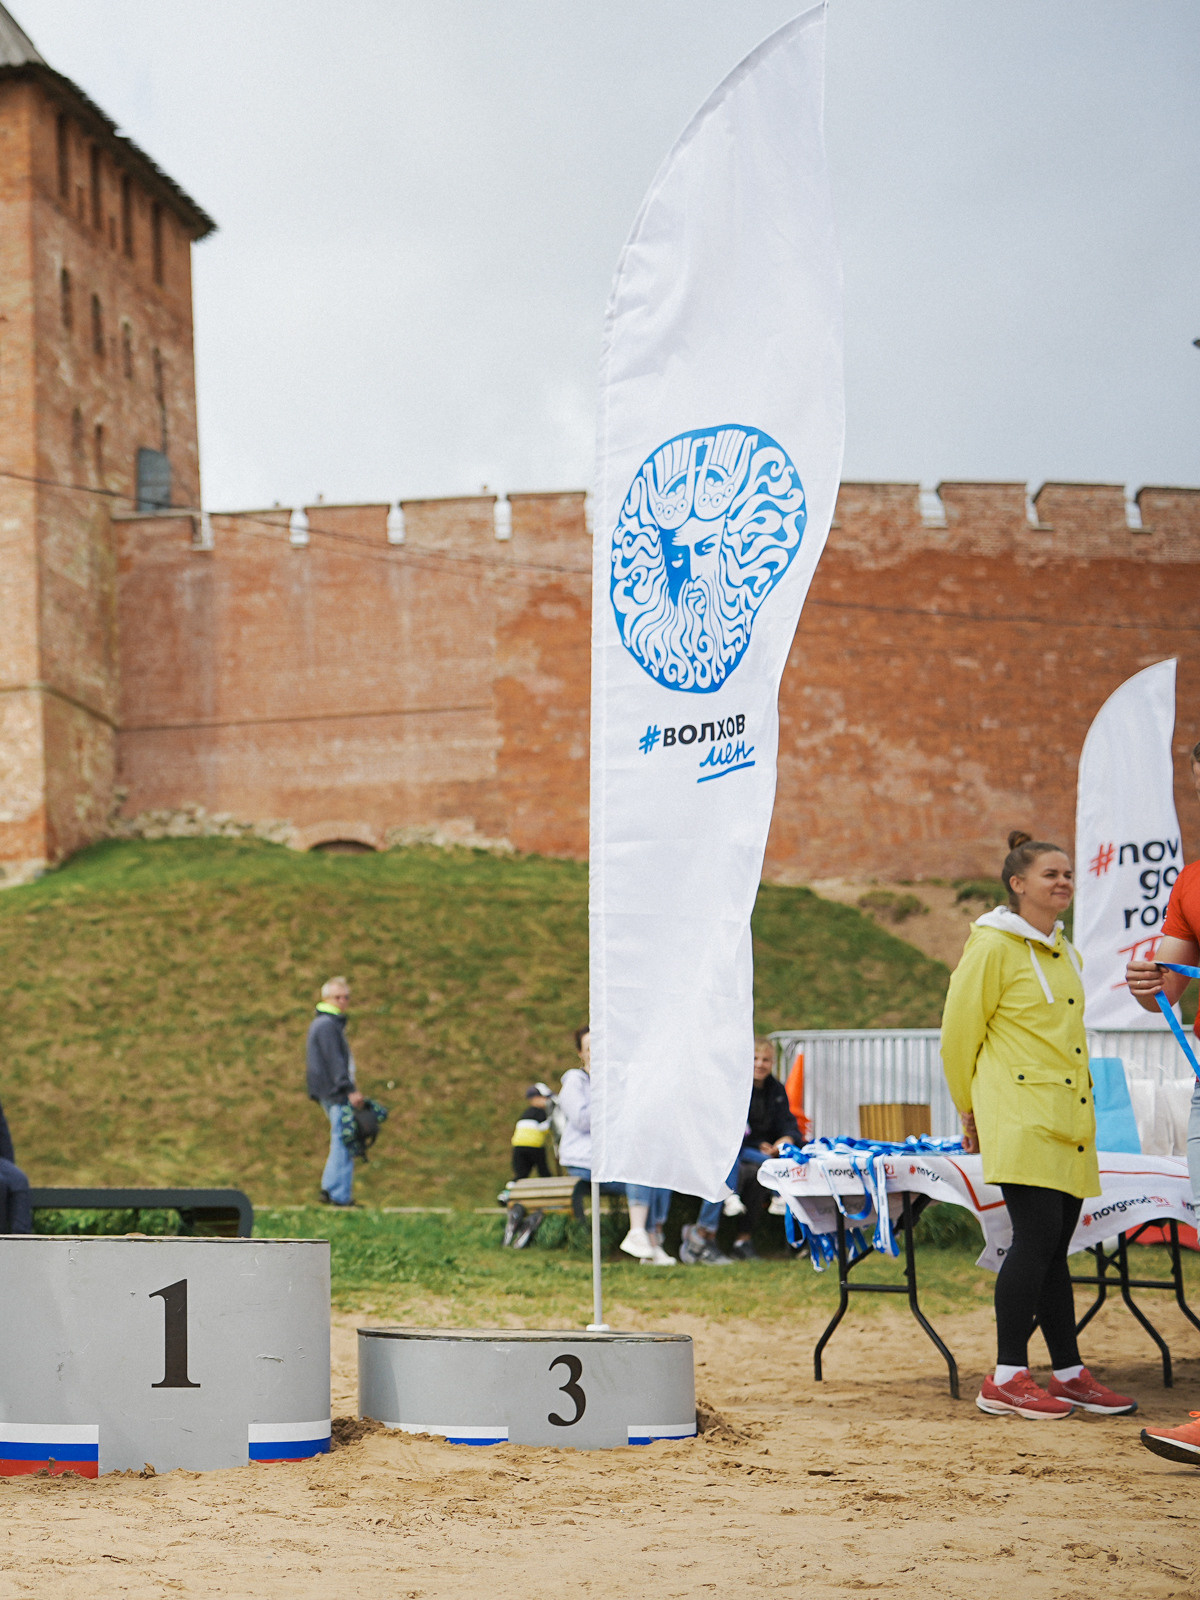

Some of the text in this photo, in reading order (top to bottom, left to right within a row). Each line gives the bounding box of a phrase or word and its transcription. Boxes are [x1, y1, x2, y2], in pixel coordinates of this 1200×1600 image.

[638, 713, 746, 755] #ВОЛХОВ
[1088, 837, 1179, 877] #nov
[148, 1277, 201, 1389] 1
[547, 1353, 587, 1427] 3
